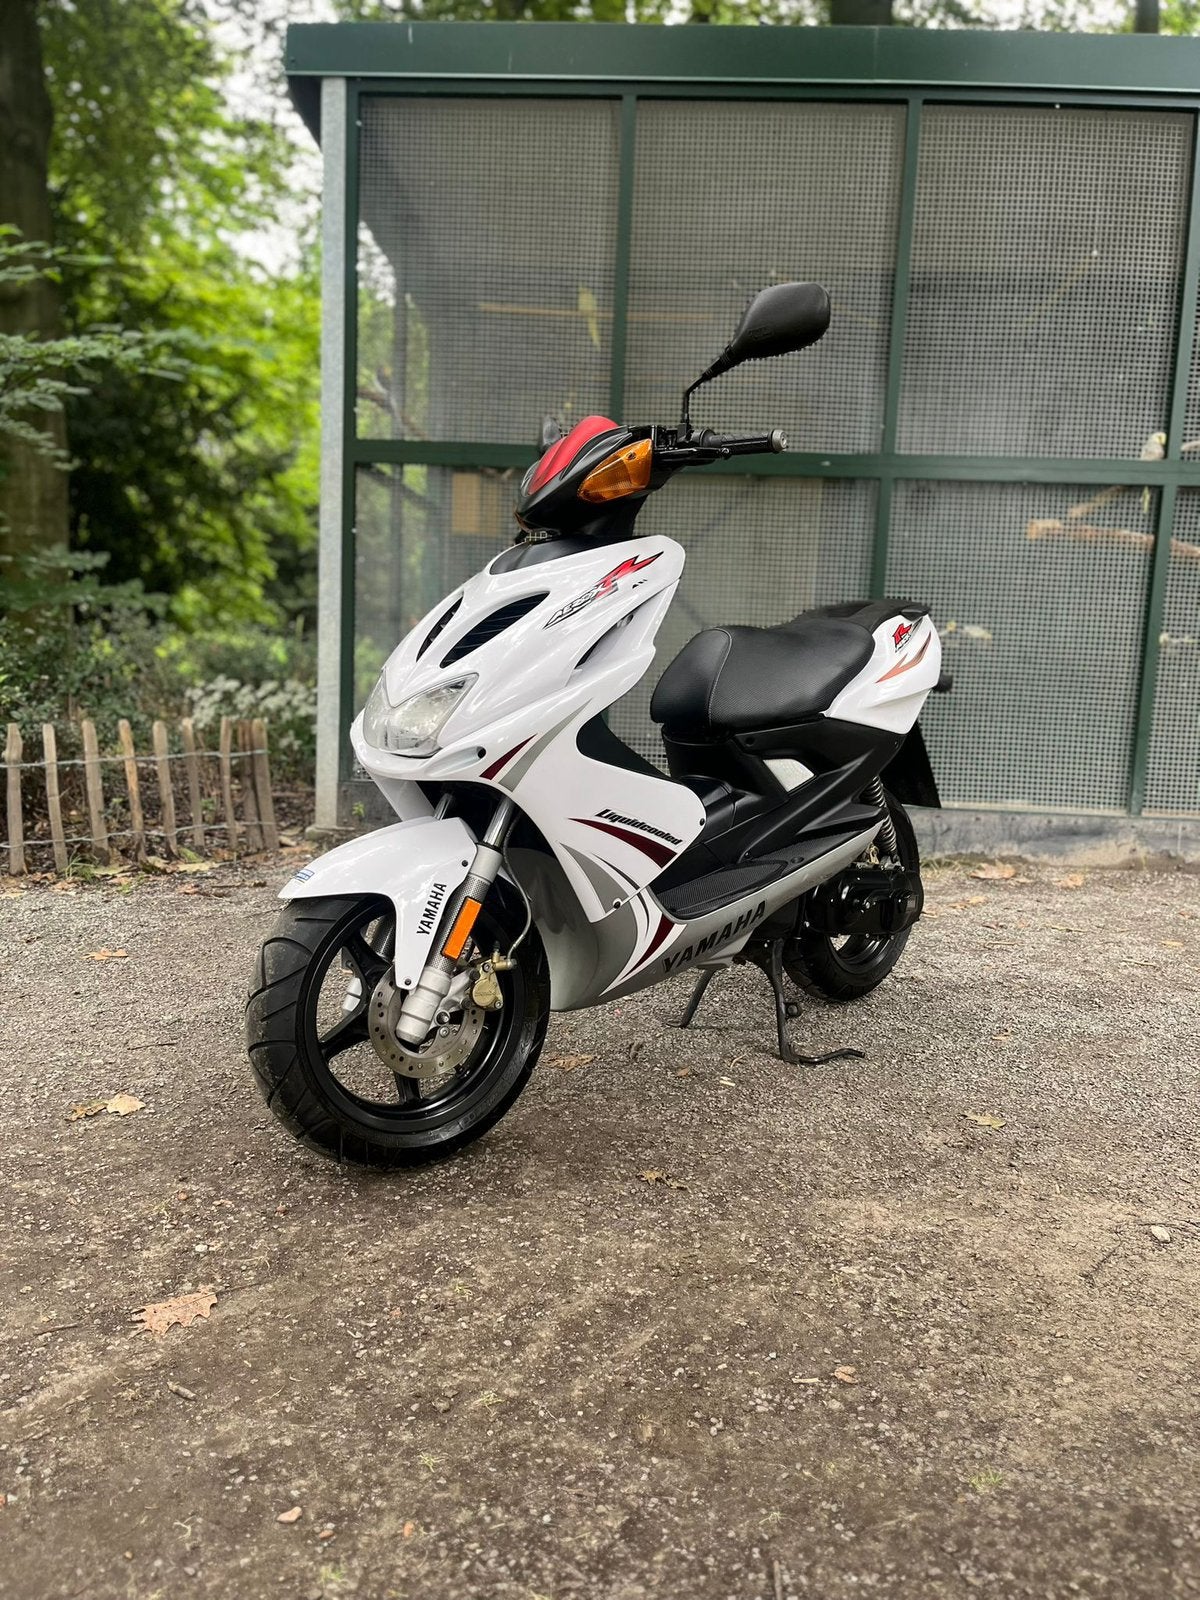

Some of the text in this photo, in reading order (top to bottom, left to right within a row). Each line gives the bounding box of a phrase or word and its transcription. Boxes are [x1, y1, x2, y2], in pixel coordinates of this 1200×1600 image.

[595, 808, 683, 846] Liquidcooled
[416, 883, 447, 935] YAMAHA
[662, 900, 766, 973] YAMAHA
